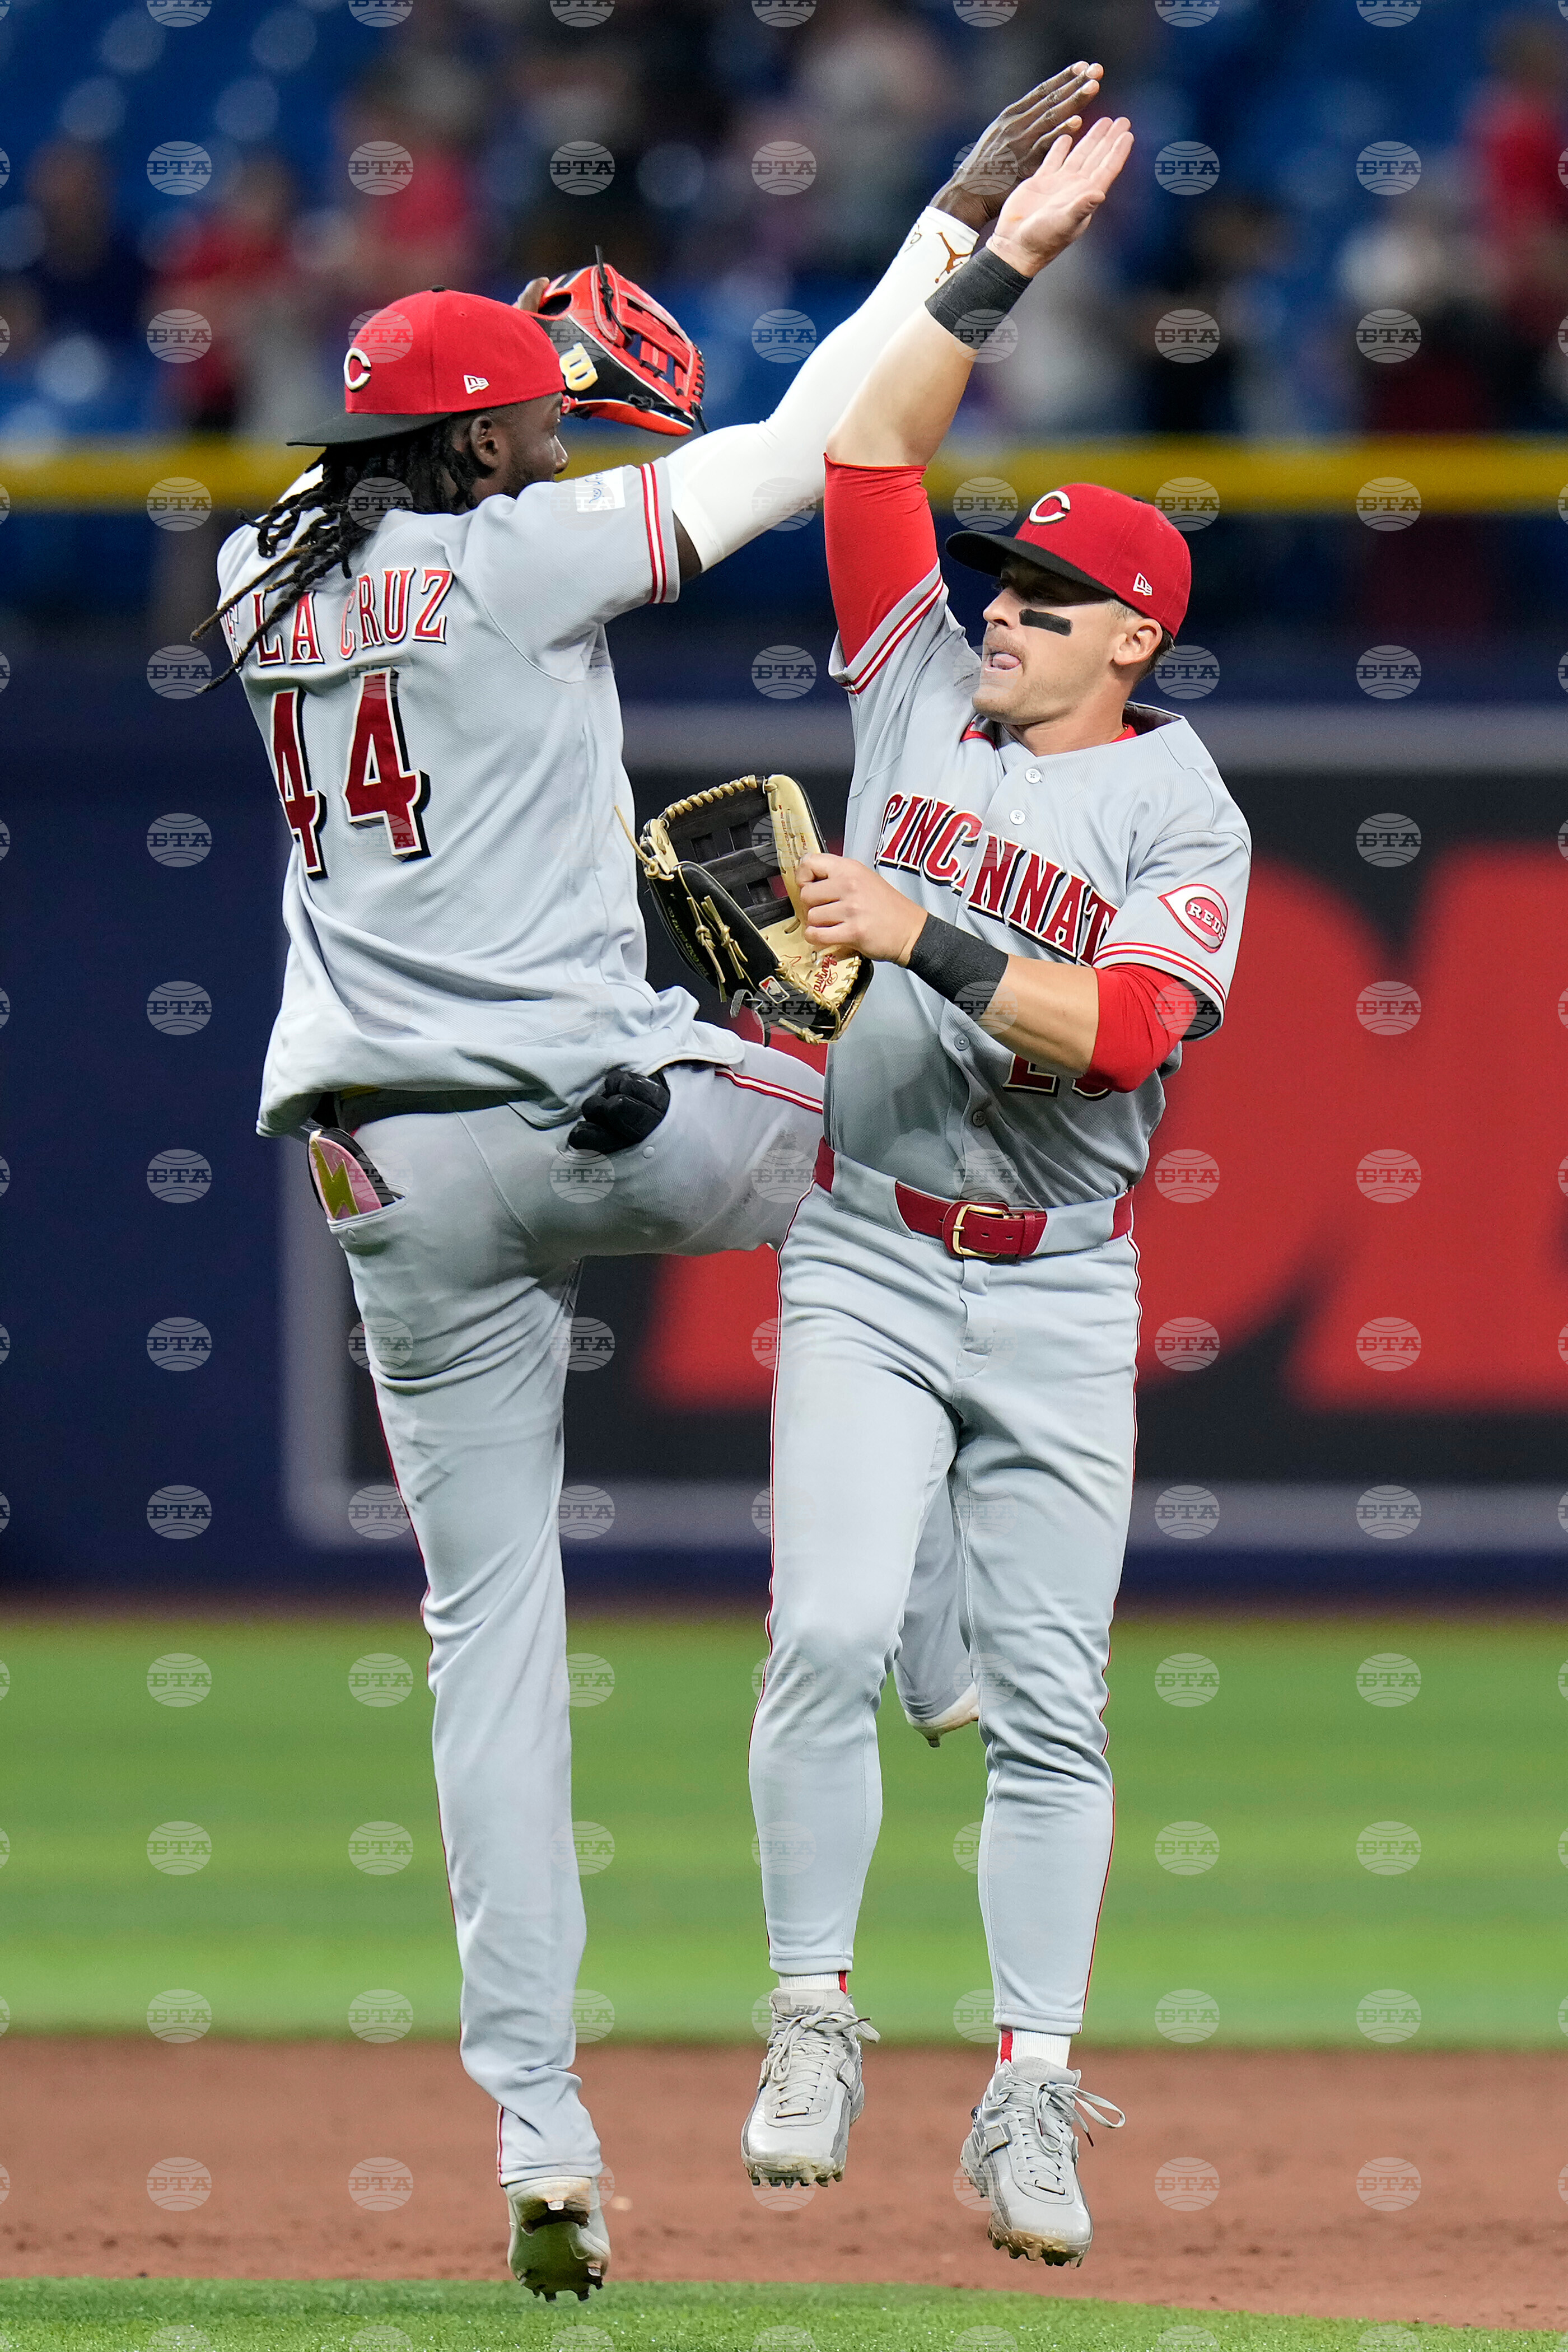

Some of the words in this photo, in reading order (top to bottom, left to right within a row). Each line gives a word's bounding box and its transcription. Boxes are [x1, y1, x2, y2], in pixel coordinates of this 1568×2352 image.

[343, 348, 372, 393] C
[1029, 491, 1071, 525] C
[251, 590, 325, 666] LA
[339, 567, 453, 659] CRUZ
[270, 668, 431, 881] 44
[1187, 902, 1225, 940] REDS
[813, 953, 838, 993] awlings
